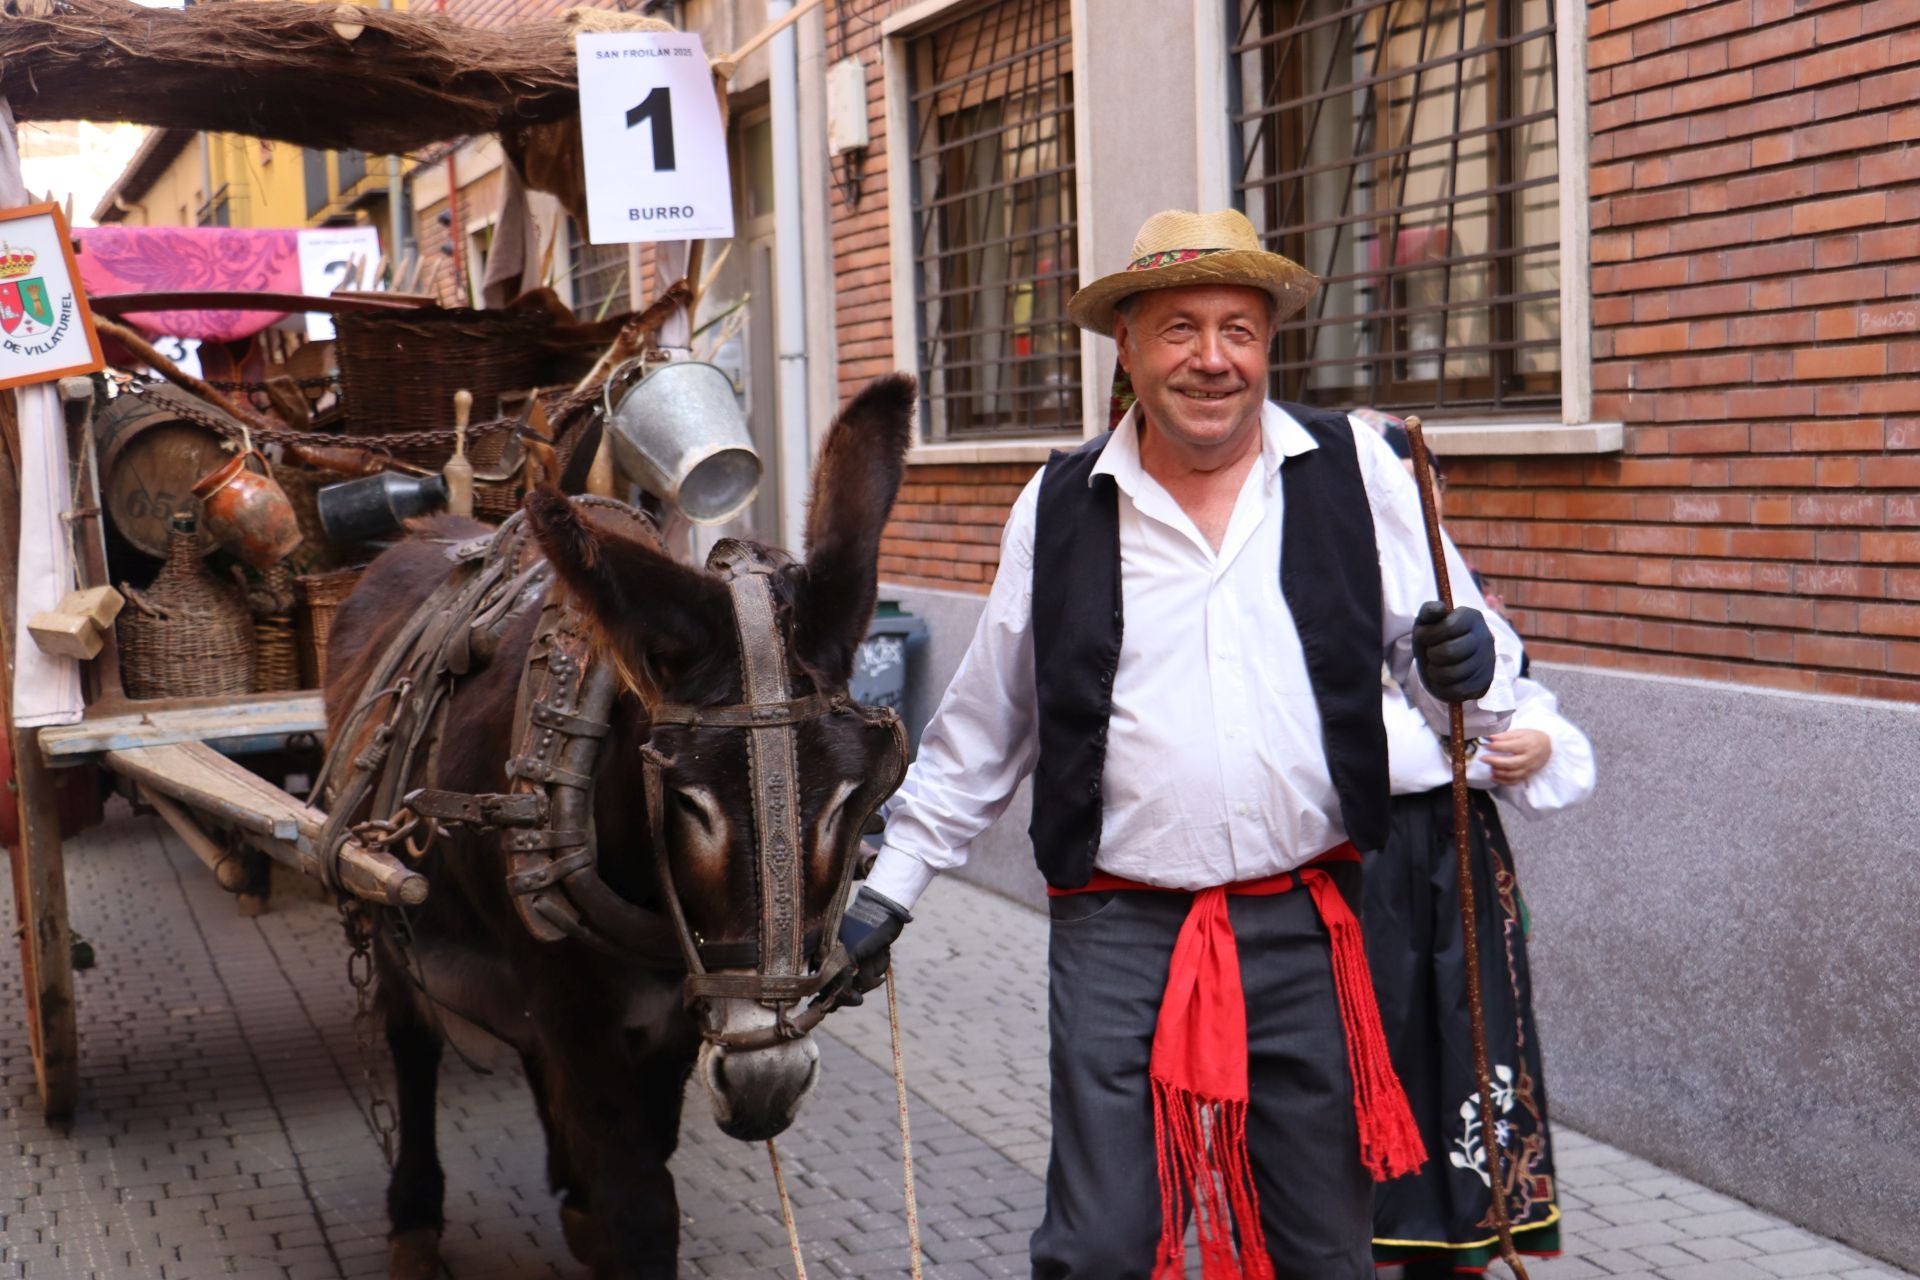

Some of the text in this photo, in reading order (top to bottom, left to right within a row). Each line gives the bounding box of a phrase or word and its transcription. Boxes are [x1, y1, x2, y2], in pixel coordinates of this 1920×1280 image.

[596, 50, 619, 59] SAN
[626, 87, 676, 172] 1
[629, 206, 694, 221] BURRO
[3, 292, 72, 356] DE VILLATURIEL
